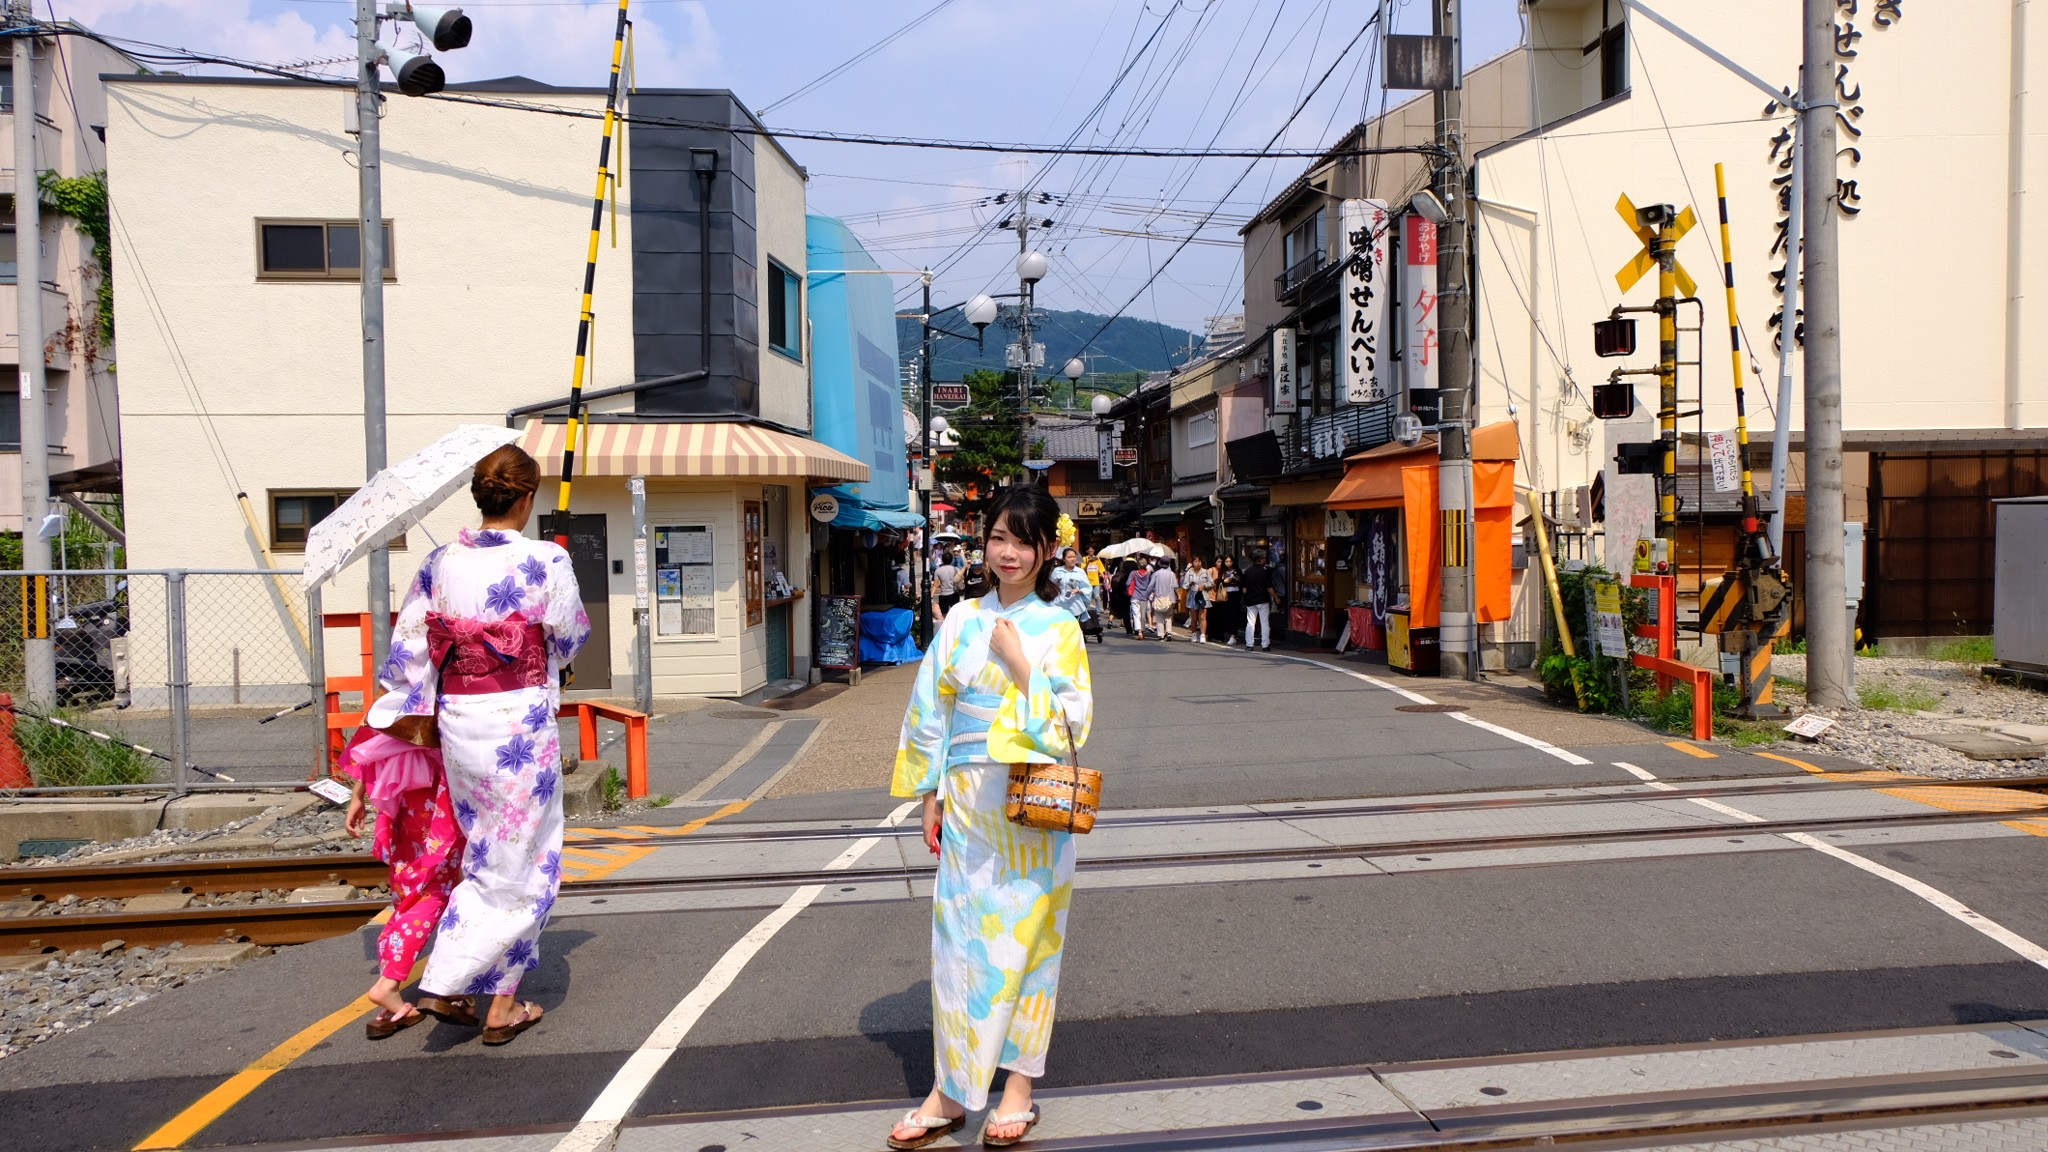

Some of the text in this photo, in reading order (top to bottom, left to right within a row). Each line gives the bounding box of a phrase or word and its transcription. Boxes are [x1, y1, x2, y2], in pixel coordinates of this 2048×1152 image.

[1348, 226, 1376, 374] 味噌せんべい
[1411, 289, 1439, 366] 夕子
[1279, 362, 1291, 397] 近江家
